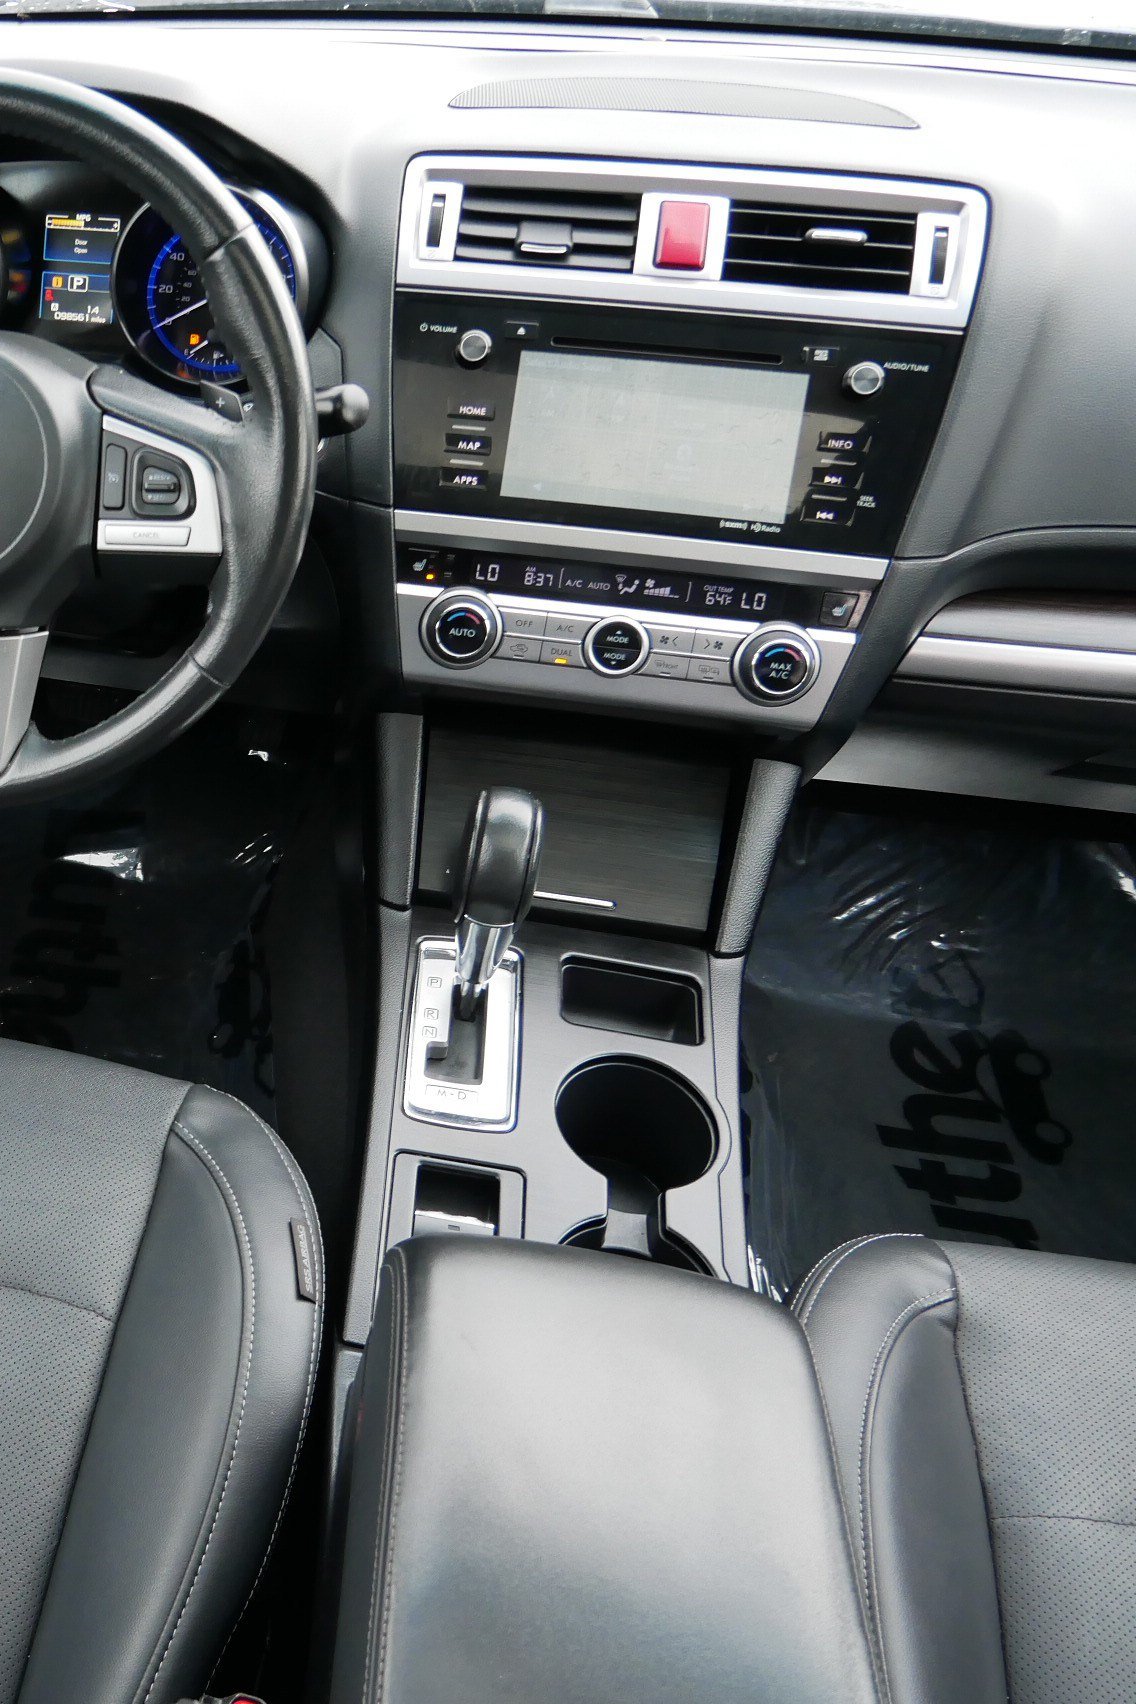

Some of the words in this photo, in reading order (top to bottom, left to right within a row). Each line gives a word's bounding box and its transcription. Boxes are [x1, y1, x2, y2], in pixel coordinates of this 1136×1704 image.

[75, 213, 92, 222] MPG
[169, 252, 185, 262] 40
[158, 284, 174, 294] 20
[429, 324, 458, 334] VOLUME
[883, 361, 930, 373] AUDIO/TUNE
[459, 405, 487, 416] HOME
[457, 440, 481, 451] MAP
[827, 439, 854, 449] INFO
[453, 475, 479, 486] APPS
[523, 572, 554, 587] 8:37
[565, 579, 583, 588] A/C
[587, 581, 611, 591] AUTO
[702, 584, 718, 592] OUT
[515, 619, 533, 628] OFF
[555, 624, 574, 633] A/C
[448, 627, 476, 638] AUTO
[605, 634, 630, 644] MODE
[550, 647, 573, 657] DUAL
[603, 651, 626, 661] MODE
[769, 661, 792, 671] MAX
[768, 670, 790, 680] A/C
